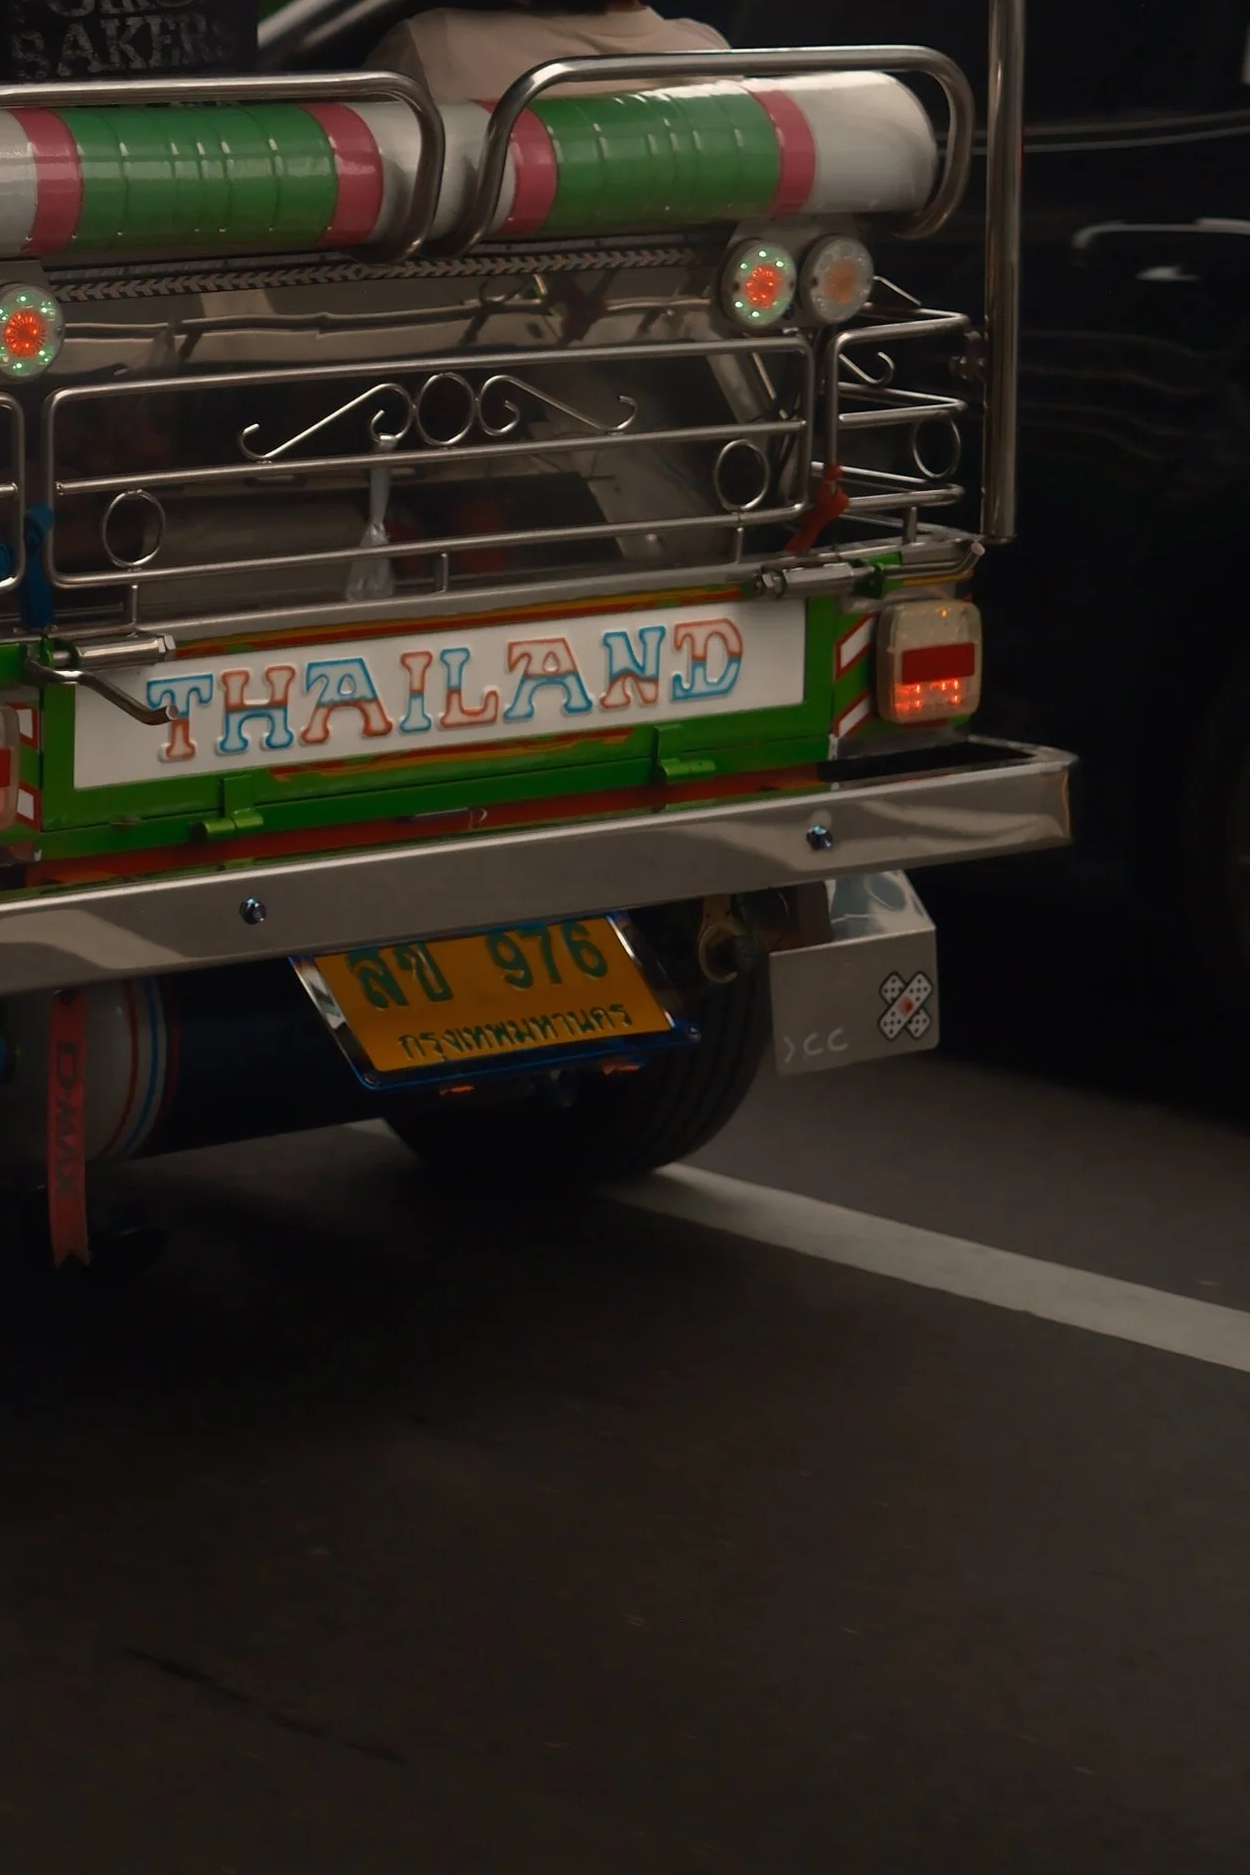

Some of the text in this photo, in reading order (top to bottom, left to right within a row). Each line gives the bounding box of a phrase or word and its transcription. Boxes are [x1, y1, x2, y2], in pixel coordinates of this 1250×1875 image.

[146, 616, 744, 763] THAILAND
[484, 920, 610, 989] 976
[397, 1003, 634, 1062] กรุงเทพมหานคร
